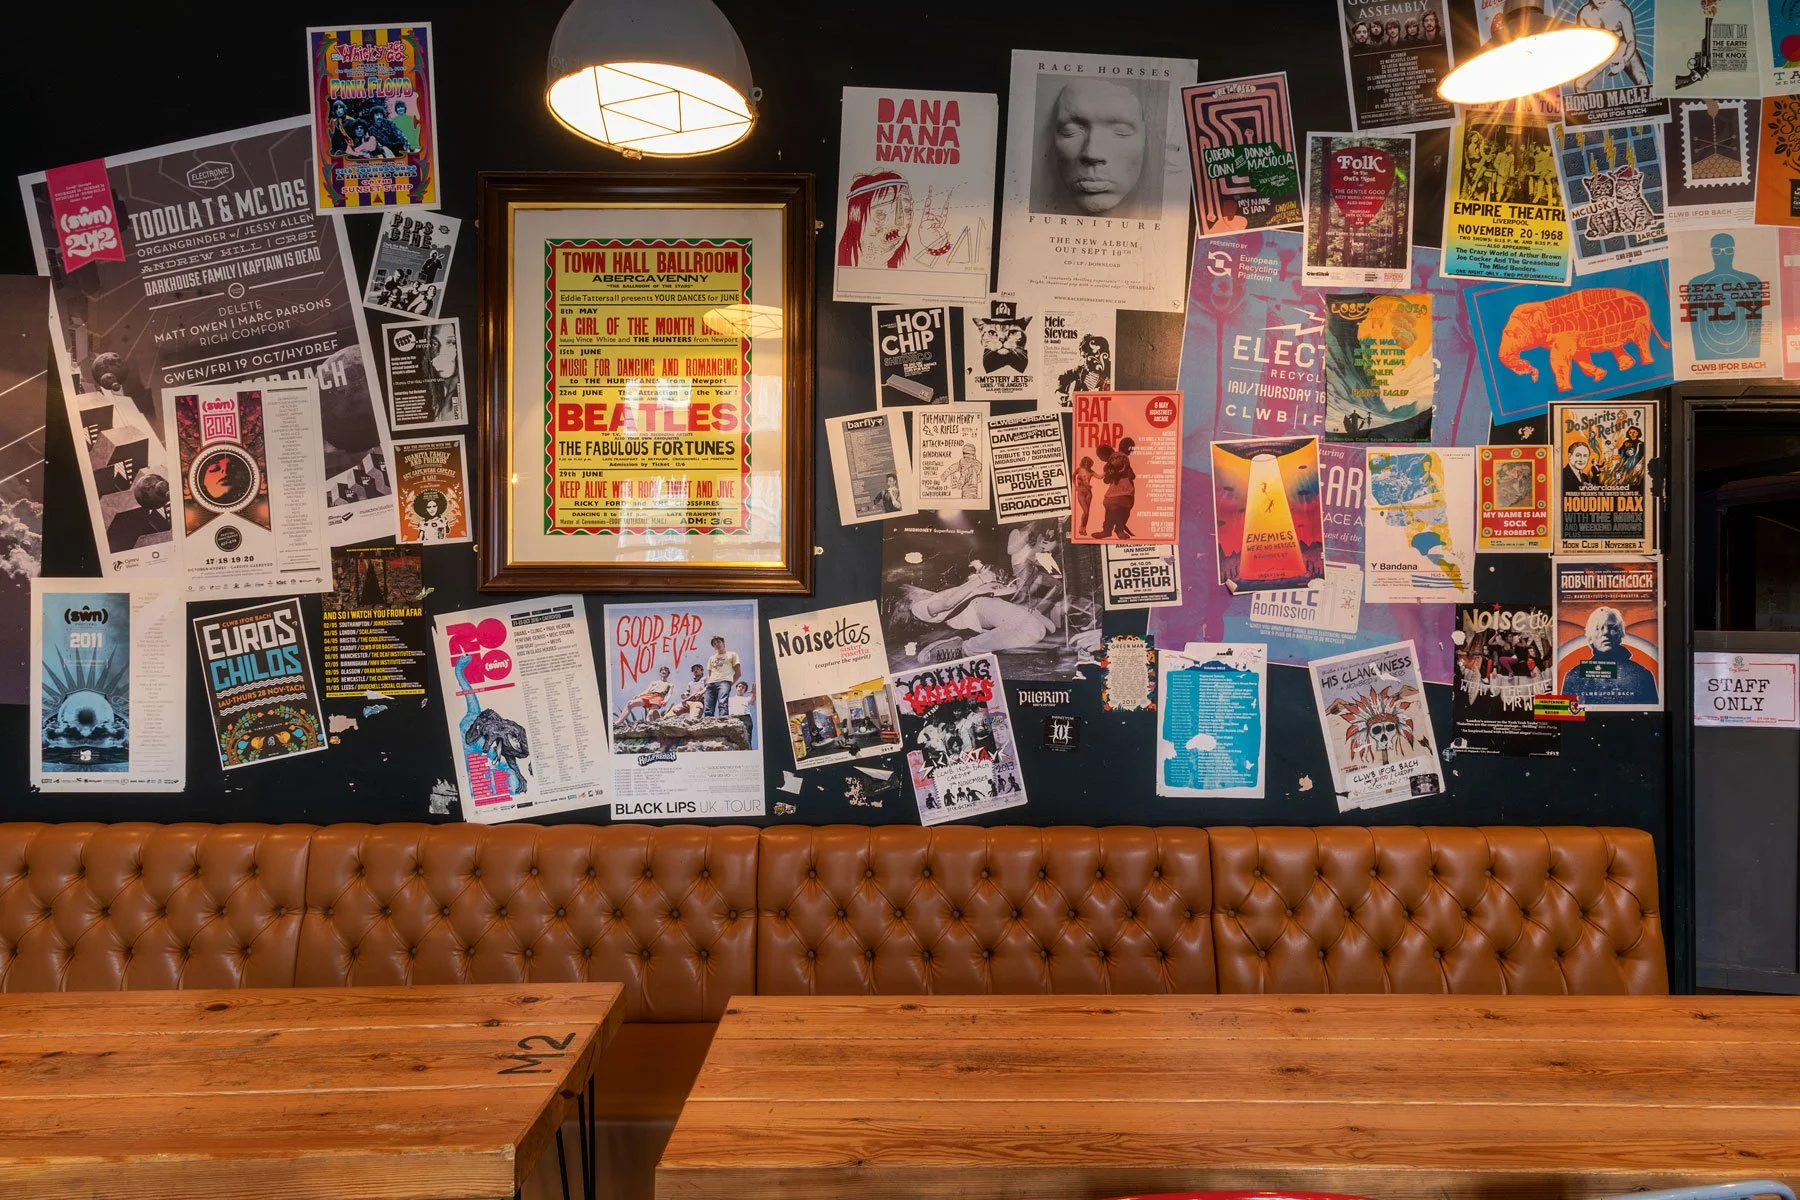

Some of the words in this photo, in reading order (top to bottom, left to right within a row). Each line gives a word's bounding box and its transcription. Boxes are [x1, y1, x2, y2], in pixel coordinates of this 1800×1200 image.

[1360, 0, 1428, 18] ASSEMBLY
[1039, 62, 1084, 73] RACE
[1099, 66, 1170, 77] HORSES
[331, 79, 366, 99] PINK
[368, 77, 414, 98] FLOYD
[1565, 93, 1605, 111] HONDO
[878, 98, 960, 126] DANA
[1627, 108, 1646, 116] BACH
[876, 124, 960, 148] NANA
[1205, 148, 1235, 163] GIDEON
[1244, 146, 1274, 160] DONNA
[1208, 163, 1235, 179] CONN
[129, 201, 207, 240] TODDLA
[202, 198, 215, 225] T
[217, 195, 234, 222] &
[234, 187, 267, 219] MC
[268, 179, 308, 208] DRS
[1454, 202, 1501, 217] EMPIRE
[1029, 216, 1160, 230] FURNITURE
[1493, 218, 1528, 226] LIVERPOOL
[138, 232, 226, 257] ORGANGRINDER
[245, 221, 276, 235] JESSY
[281, 213, 314, 228] ALLEN
[1458, 224, 1513, 237] NOVEMBER
[1521, 229, 1532, 238] 20
[1541, 230, 1563, 240] 1968
[563, 252, 606, 273] TOWN
[613, 252, 649, 273] HALL
[657, 252, 738, 273] BALLROOM
[1240, 255, 1278, 266] European
[1238, 272, 1272, 282] Platform
[1239, 264, 1278, 276] Recycling
[592, 275, 708, 283] ABERGAVENNY
[1679, 284, 1715, 294] GET
[1722, 282, 1770, 291] CAPE
[561, 294, 581, 302] Eddie
[581, 294, 619, 302] Tattersall
[621, 295, 653, 303] presents
[655, 294, 676, 302] YOUR
[678, 294, 706, 302] DANCES
[708, 294, 718, 302] for
[720, 294, 739, 302] JUNE
[1680, 293, 1725, 301] WEAR
[1731, 292, 1770, 300] CAPE
[219, 300, 262, 317] DELETE
[1680, 301, 1770, 322] FLY
[155, 329, 185, 343] MATT
[191, 321, 226, 335] OWEN
[238, 311, 272, 326] MARC
[276, 299, 331, 318] PARSONS
[896, 309, 941, 334] HOT
[1045, 316, 1065, 328] Meic
[200, 331, 228, 346] RICH
[232, 320, 290, 340] COMFORT
[1044, 328, 1078, 339] Stevens
[881, 332, 934, 356] CHIP
[1691, 363, 1717, 371] CLWB
[1228, 380, 1310, 402] IAU/THURSDAY
[559, 404, 738, 431] BEATLES
[1078, 397, 1112, 422] RAT
[1226, 404, 1287, 422] CLWB
[940, 425, 958, 434] RIFLES
[1566, 418, 1581, 434] Do
[1581, 410, 1616, 430] Spirits
[1078, 424, 1123, 448] TRAP
[559, 441, 581, 455] THE
[586, 441, 648, 455] FABULOUS
[653, 441, 734, 455] FORTUNES
[1032, 447, 1061, 455] NOTHING
[997, 472, 1039, 484] BRITISH
[1043, 468, 1064, 477] SEA
[1011, 479, 1052, 491] POWER
[1001, 495, 1067, 511] BROADCAST
[1564, 497, 1614, 512] HOUDINI
[1617, 497, 1643, 512] DAX
[1246, 531, 1293, 543] ENEMIES
[1114, 566, 1169, 578] JOSEPH
[1371, 563, 1377, 571] Y
[1379, 562, 1417, 571] Bandana
[1114, 577, 1170, 589] ARTHUR
[1561, 575, 1594, 588] ROBYN
[1597, 575, 1652, 588] HITCHCOCK
[324, 612, 336, 620] AND
[351, 610, 372, 618] WATCH
[373, 610, 386, 618] YOU
[387, 609, 404, 617] FROM
[1253, 602, 1316, 621] ADMISSION
[203, 609, 296, 660] EUROS
[616, 615, 663, 648] GOOD
[670, 613, 703, 637] BAD
[775, 617, 870, 658] Noisettes
[70, 633, 102, 648] 2011
[620, 643, 656, 689] NOT
[663, 634, 697, 670] EVIL
[1708, 679, 1770, 692] STAFF
[1714, 697, 1764, 711] ONLY
[616, 802, 662, 814] BLACK
[667, 802, 696, 813] LIPS
[700, 801, 718, 813] UK
[724, 800, 760, 811] TOUR
[497, 1033, 576, 1074] M2
